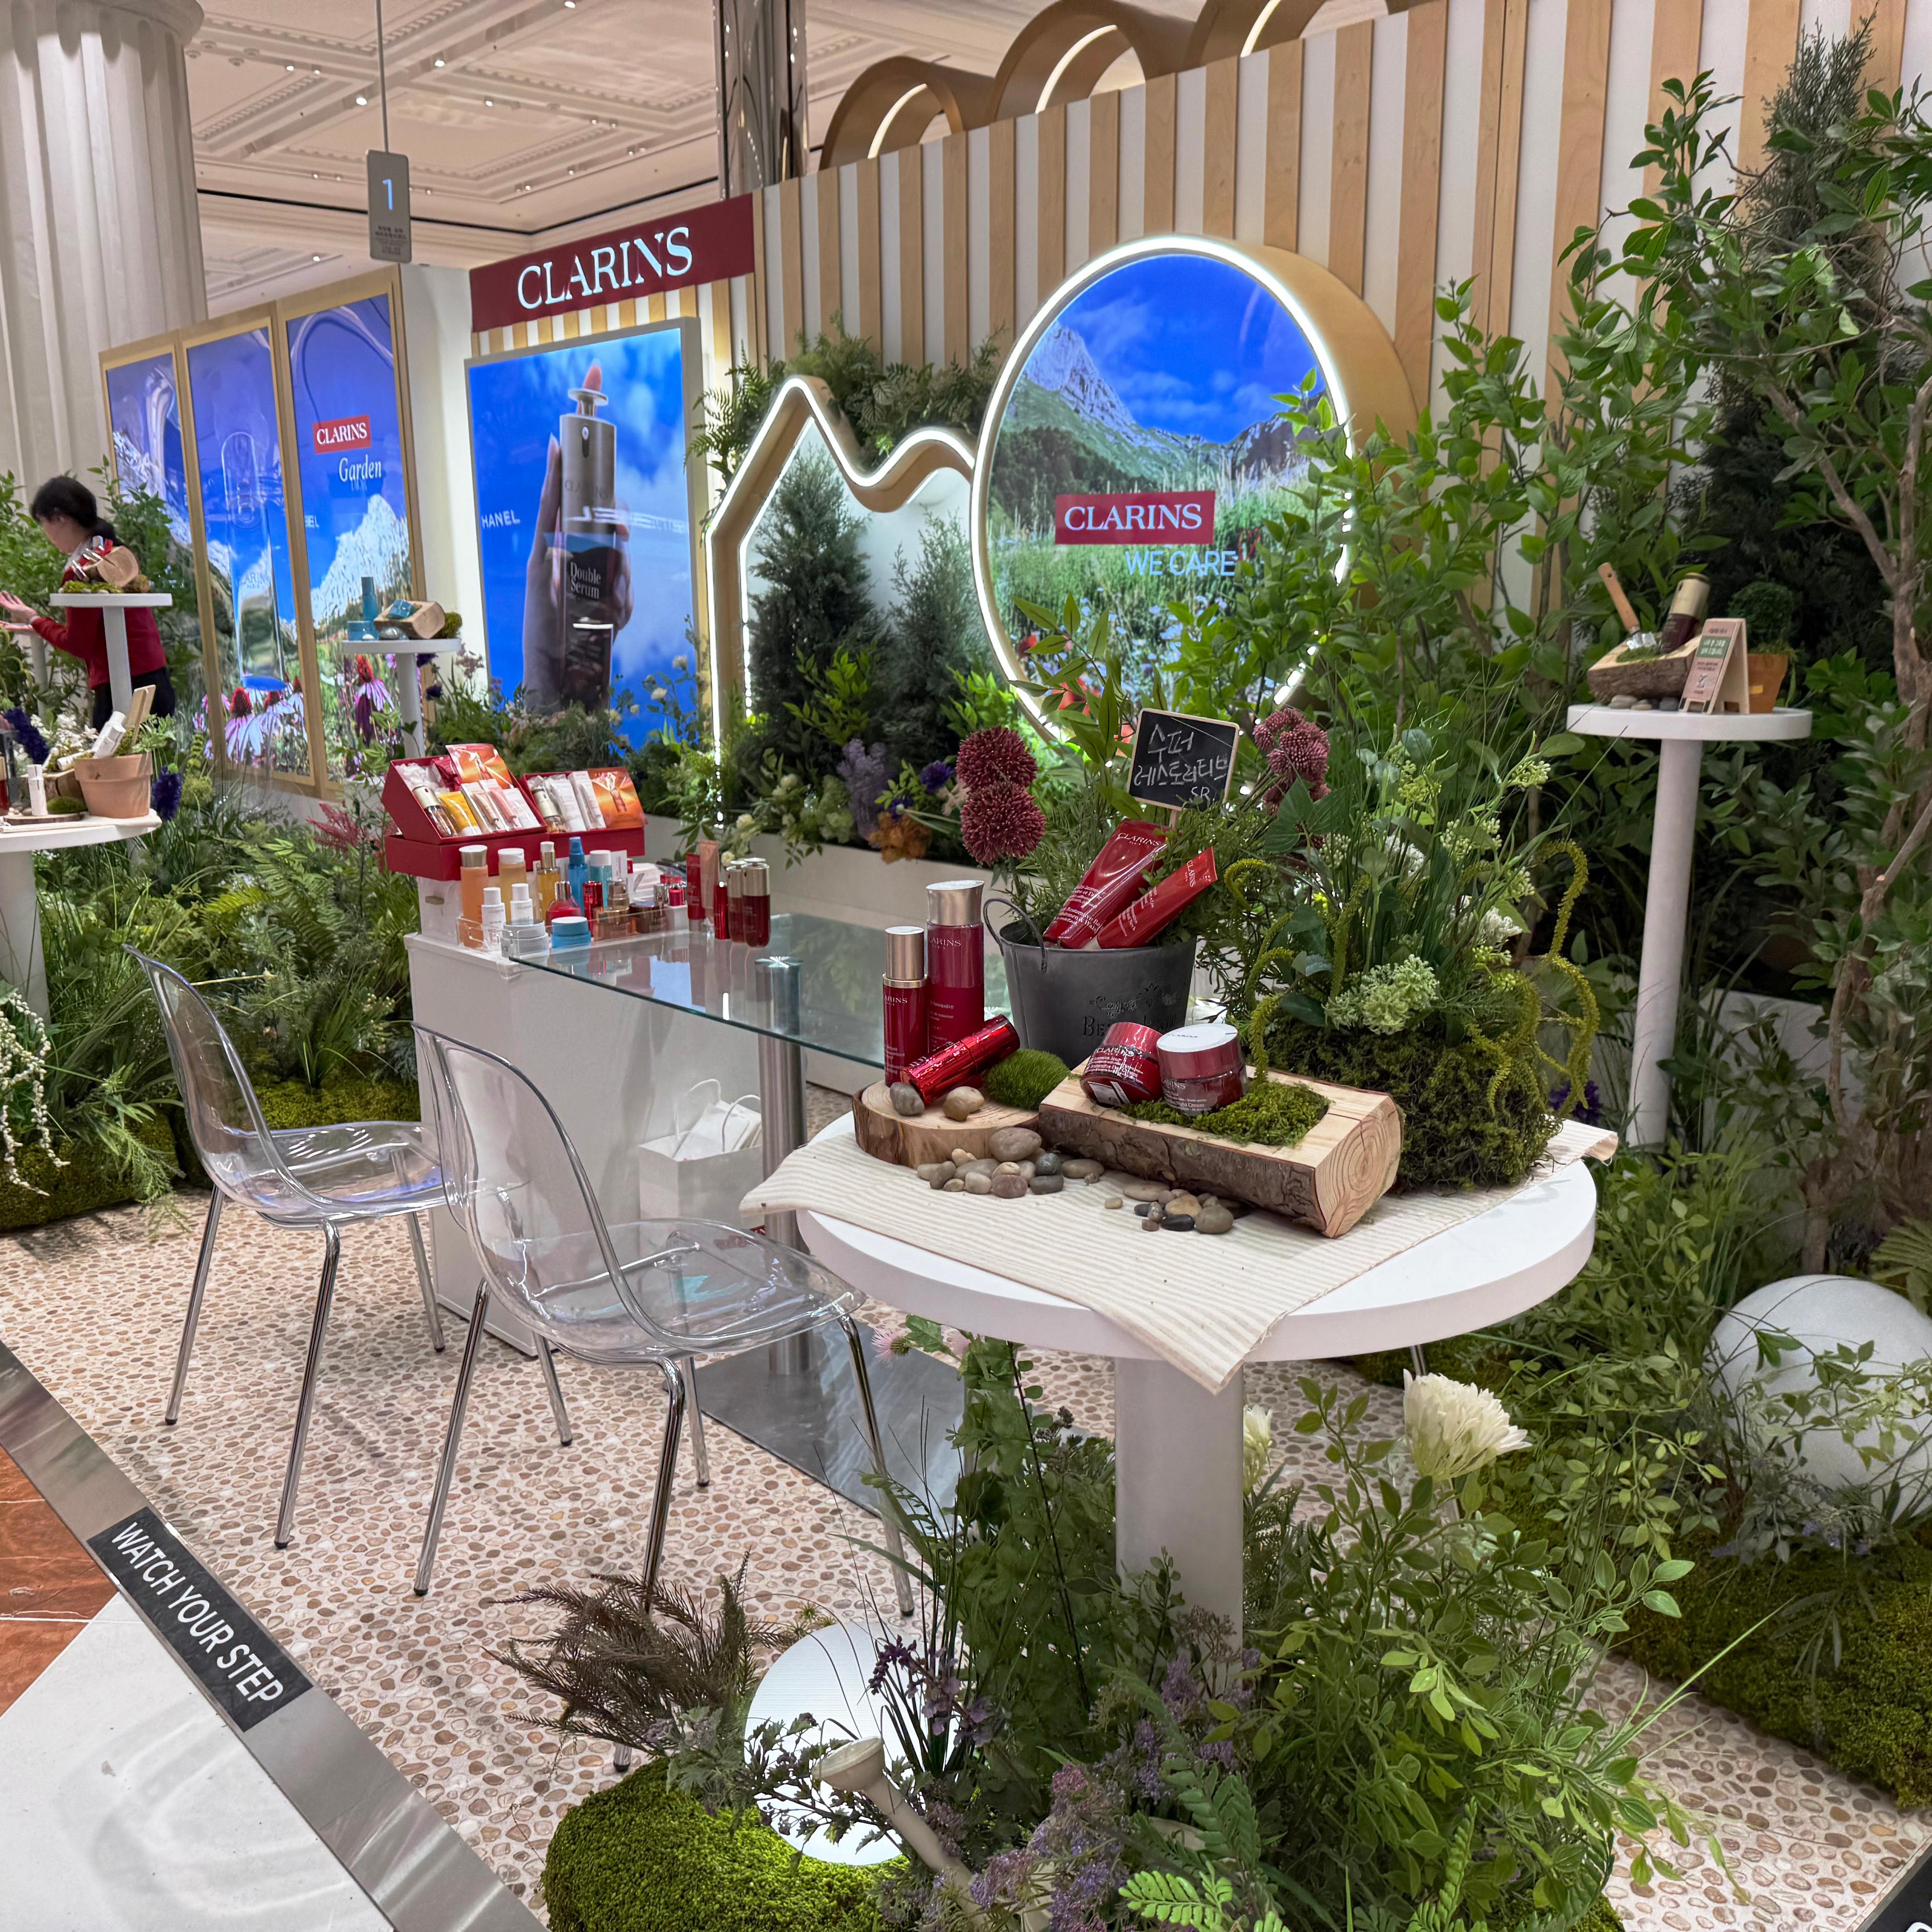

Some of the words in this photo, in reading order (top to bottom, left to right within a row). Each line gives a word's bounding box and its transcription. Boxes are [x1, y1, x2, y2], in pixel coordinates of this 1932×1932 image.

[382, 179, 393, 210] 1
[518, 226, 693, 309] CLARINS
[316, 422, 368, 445] CLARINS
[339, 453, 382, 482] Garden
[481, 509, 520, 529] HANEL
[1064, 503, 1202, 531] CLARINS
[571, 561, 601, 585] Double
[1125, 550, 1163, 577] WE
[1169, 550, 1237, 577] CARE
[571, 578, 599, 600] Serum
[1148, 723, 1194, 763] 수퍼
[1117, 832, 1161, 846] CLARINS
[930, 937, 961, 946] ARINS
[884, 995, 908, 1004] ARINS
[112, 1521, 186, 1595] WATCH
[168, 1585, 234, 1654] YOUR
[216, 1644, 284, 1702] STEP
